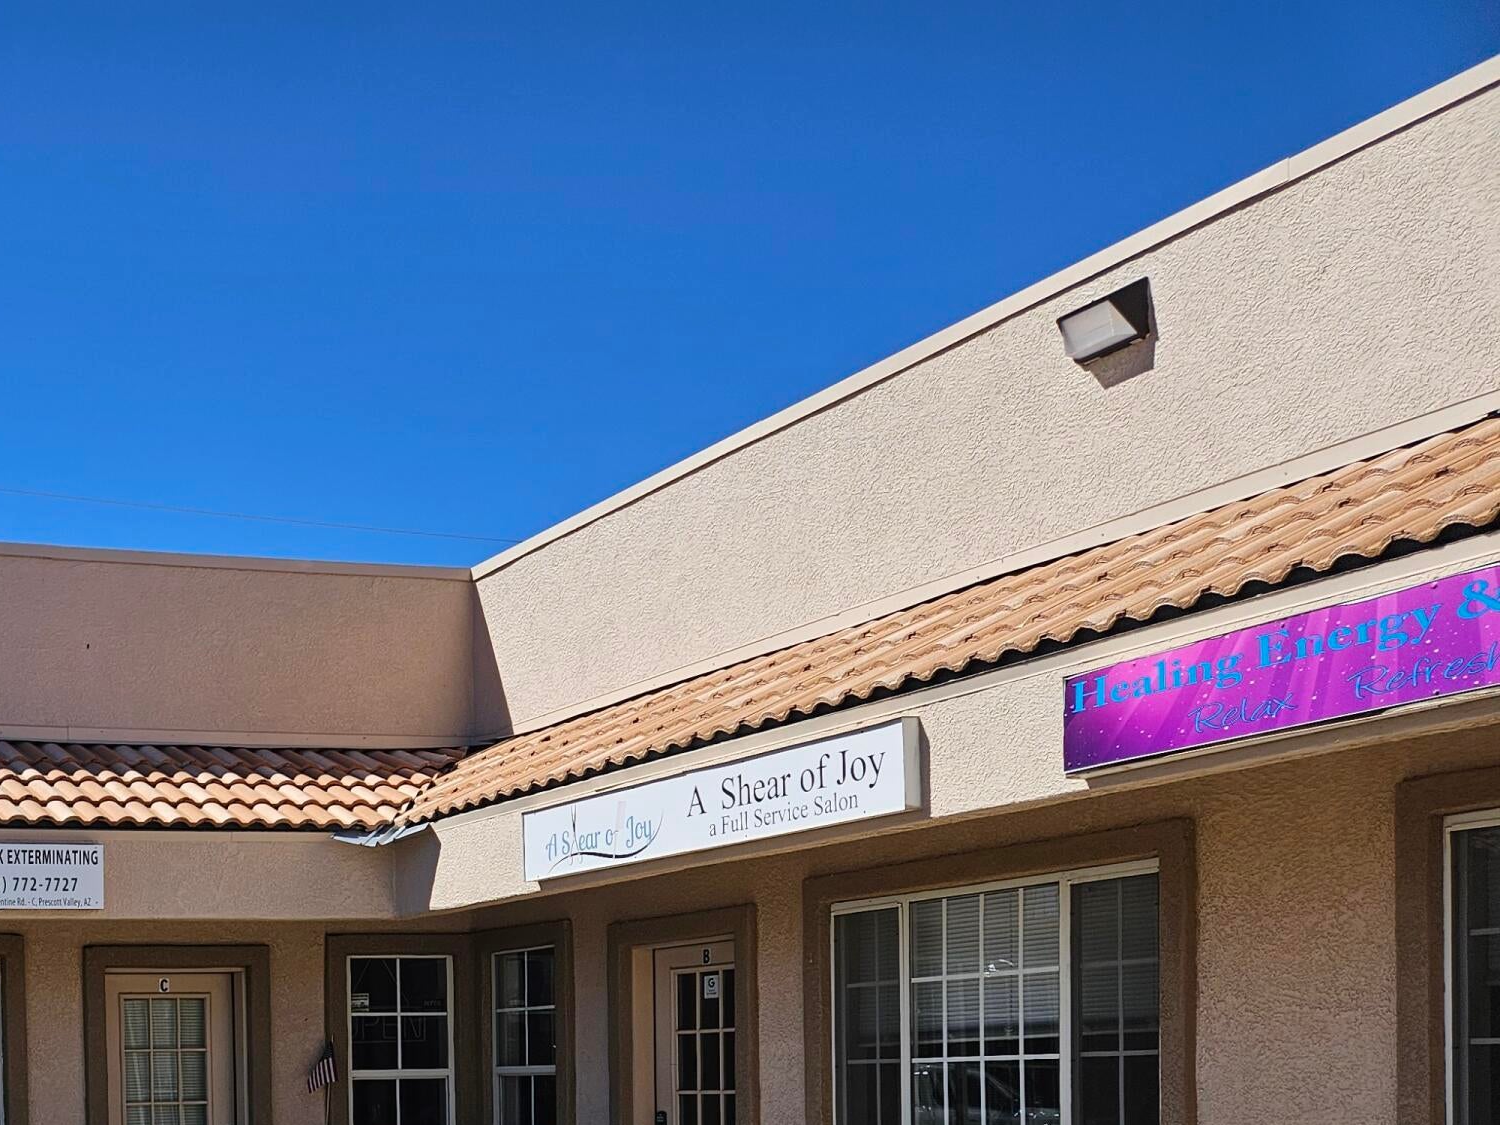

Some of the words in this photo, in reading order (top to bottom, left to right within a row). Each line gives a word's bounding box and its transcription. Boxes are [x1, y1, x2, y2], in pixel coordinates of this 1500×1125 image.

[1071, 656, 1245, 714] Healing
[1255, 603, 1442, 669] Energy
[1457, 579, 1500, 620] &
[1188, 692, 1298, 733] Relax
[687, 786, 707, 817] A
[721, 773, 792, 810] Shear
[800, 753, 831, 792] of
[836, 750, 886, 789] Joy
[709, 823, 717, 836] a
[722, 811, 749, 834] Full
[754, 802, 808, 828] Service
[813, 792, 859, 816] Salon
[545, 833, 557, 861] A
[626, 815, 653, 849] Joy
[7, 849, 99, 866] EXTERMINATING
[12, 876, 79, 892] 772-7727
[38, 897, 63, 906] Prescott
[83, 897, 92, 906] AZ
[703, 949, 710, 963] B
[160, 979, 168, 992] C
[708, 978, 715, 988] G
